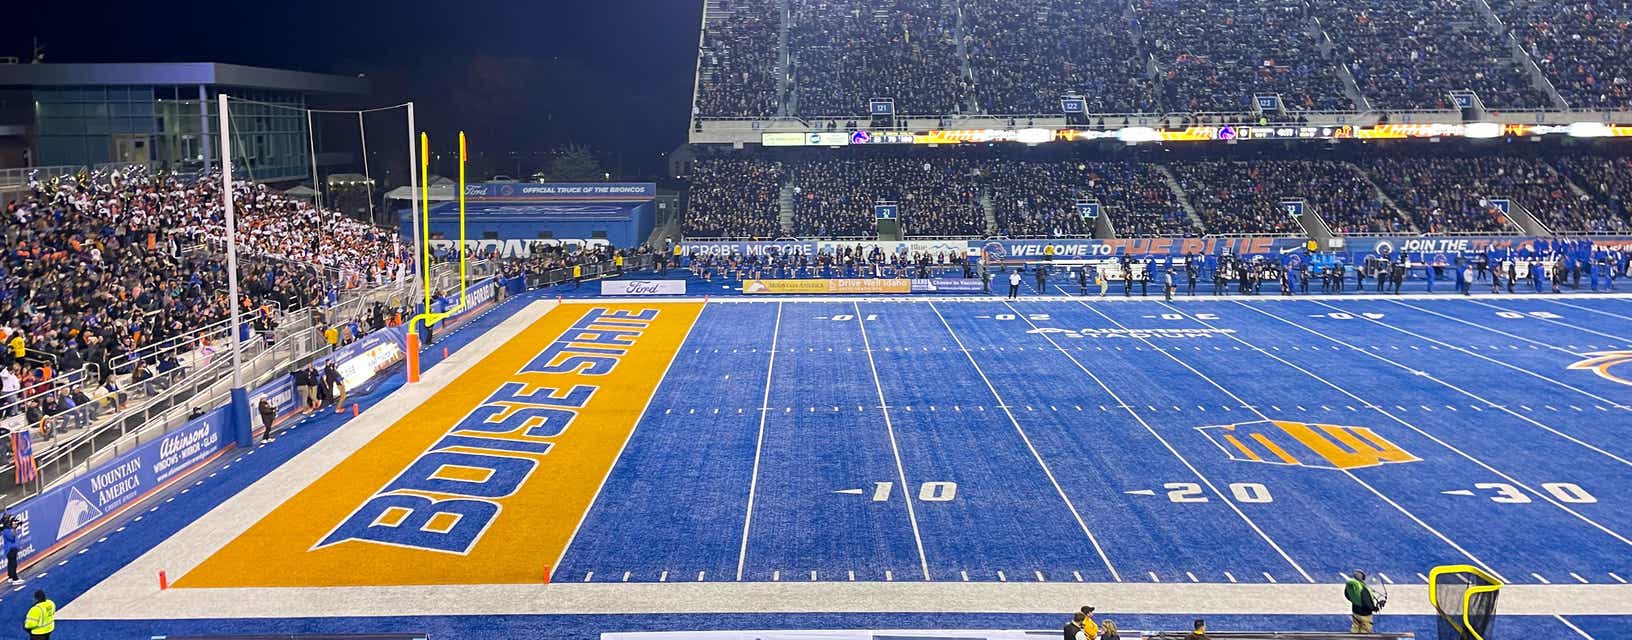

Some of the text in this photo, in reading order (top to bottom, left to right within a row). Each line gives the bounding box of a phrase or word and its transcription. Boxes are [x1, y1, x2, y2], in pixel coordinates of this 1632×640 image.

[876, 103, 888, 112] 121
[464, 184, 488, 196] Ford
[522, 186, 555, 194] OFFICIAL
[557, 186, 580, 194] TRUCK
[1010, 244, 1111, 257] WELCOME TO
[1400, 239, 1436, 252] JOIN
[1439, 239, 1469, 251] THE
[626, 281, 660, 294] Ford
[515, 306, 661, 378] STATE
[153, 453, 180, 474] WINDOWS
[203, 432, 218, 449] GLASS
[90, 457, 142, 493] MOUNTAIN
[305, 381, 602, 557] BOISE
[99, 474, 140, 507] AMERICA
